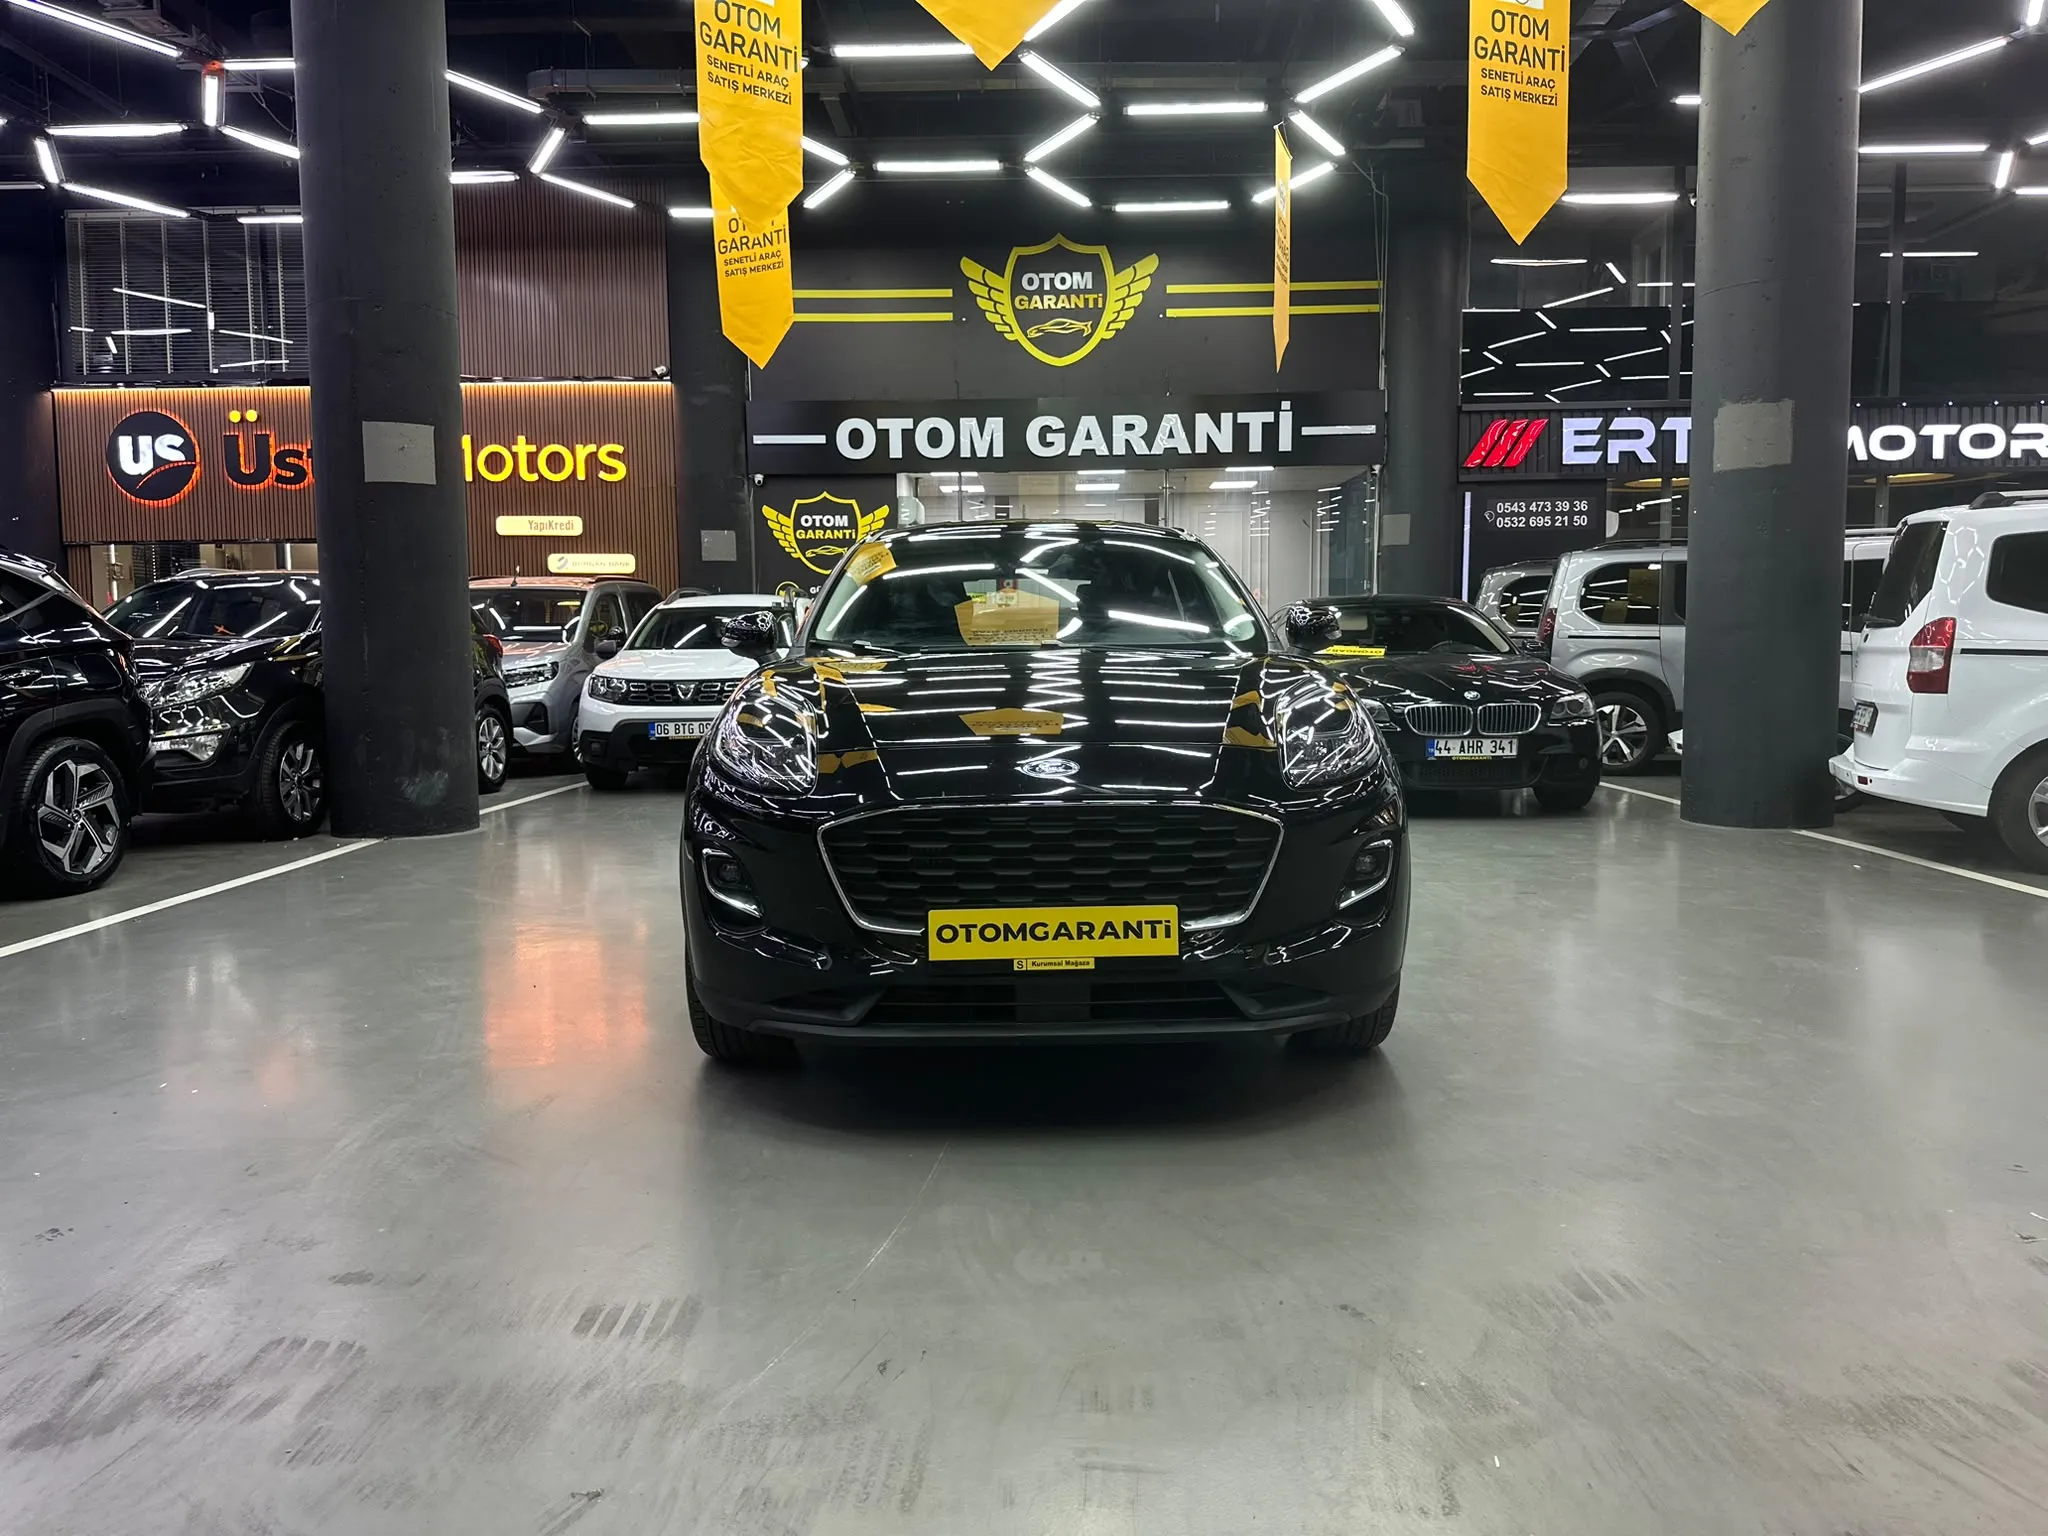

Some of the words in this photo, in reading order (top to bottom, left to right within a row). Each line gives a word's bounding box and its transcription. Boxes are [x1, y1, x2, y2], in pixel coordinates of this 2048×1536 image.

[714, 0, 780, 39] OTOM
[1491, 9, 1549, 41] OTOM
[700, 21, 798, 73] GARANTİ
[1474, 35, 1566, 72] GARANTİ
[707, 54, 754, 78] SENETLİ
[757, 70, 789, 91] ARAÇ
[1481, 67, 1524, 85] SENETLİ
[1525, 76, 1556, 92] ARAÇ
[707, 71, 740, 94] SATIŞ
[743, 82, 792, 105] MERKEZİ
[1481, 85, 1511, 102] SATIŞ
[1514, 90, 1558, 107] MERKEZİ
[718, 224, 787, 255] GARANTİ
[724, 252, 757, 267] SENETLİ
[758, 250, 782, 264] ARAÇ
[725, 267, 748, 278] SATIŞ
[749, 258, 784, 274] MERKEZİ
[1021, 271, 1093, 291] OTOM
[836, 416, 1004, 460] OTOM
[1025, 400, 1293, 458] GARANTİ
[1496, 501, 1526, 513] 0543
[1529, 501, 1552, 512] 473
[1555, 501, 1570, 512] 39
[1573, 500, 1588, 512] 36
[800, 515, 848, 527] OTOM
[1496, 517, 1526, 528] 0532
[1529, 516, 1552, 527] 695
[1555, 516, 1568, 527] 21
[1573, 515, 1588, 526] 50
[656, 724, 669, 735] 06
[674, 723, 694, 735] BTG
[1435, 740, 1451, 754] 44
[1459, 740, 1484, 754] AHR
[1490, 739, 1514, 754] 341
[1016, 960, 1024, 970] S
